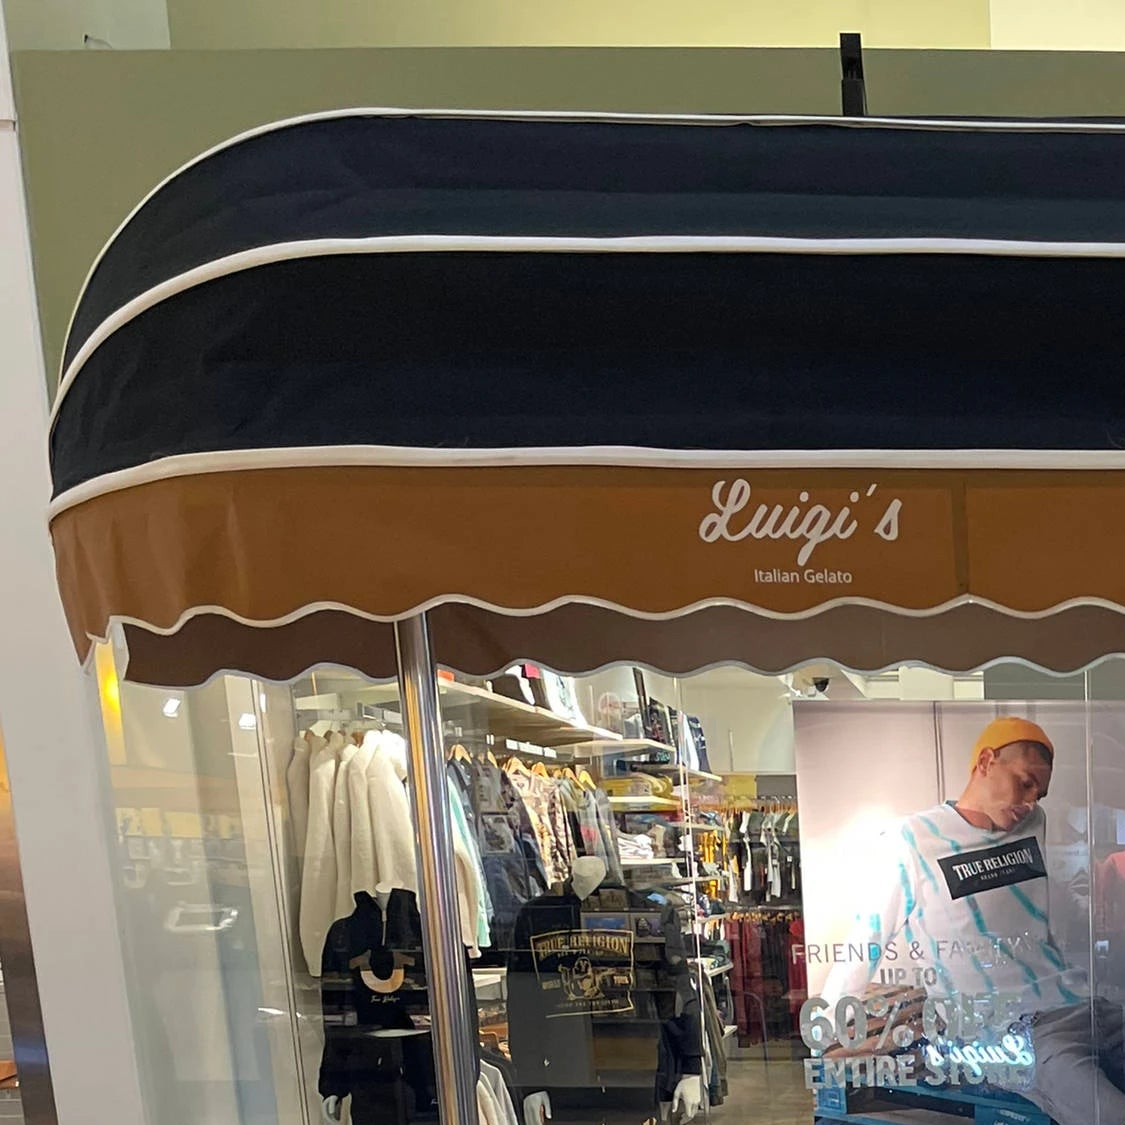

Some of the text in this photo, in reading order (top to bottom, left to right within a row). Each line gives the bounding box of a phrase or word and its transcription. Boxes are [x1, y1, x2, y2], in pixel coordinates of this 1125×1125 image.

[699, 478, 902, 567] Luigi's
[754, 568, 853, 584] Italian Gelato
[952, 848, 1034, 881] TRUE RELIGION
[535, 936, 565, 960] TRUE
[569, 934, 630, 955] RELIGION
[791, 942, 898, 965] FRIENDS
[908, 940, 925, 960] &
[879, 967, 938, 986] UP TO
[800, 993, 915, 1051] 60%
[803, 1054, 917, 1090] ENTIRE
